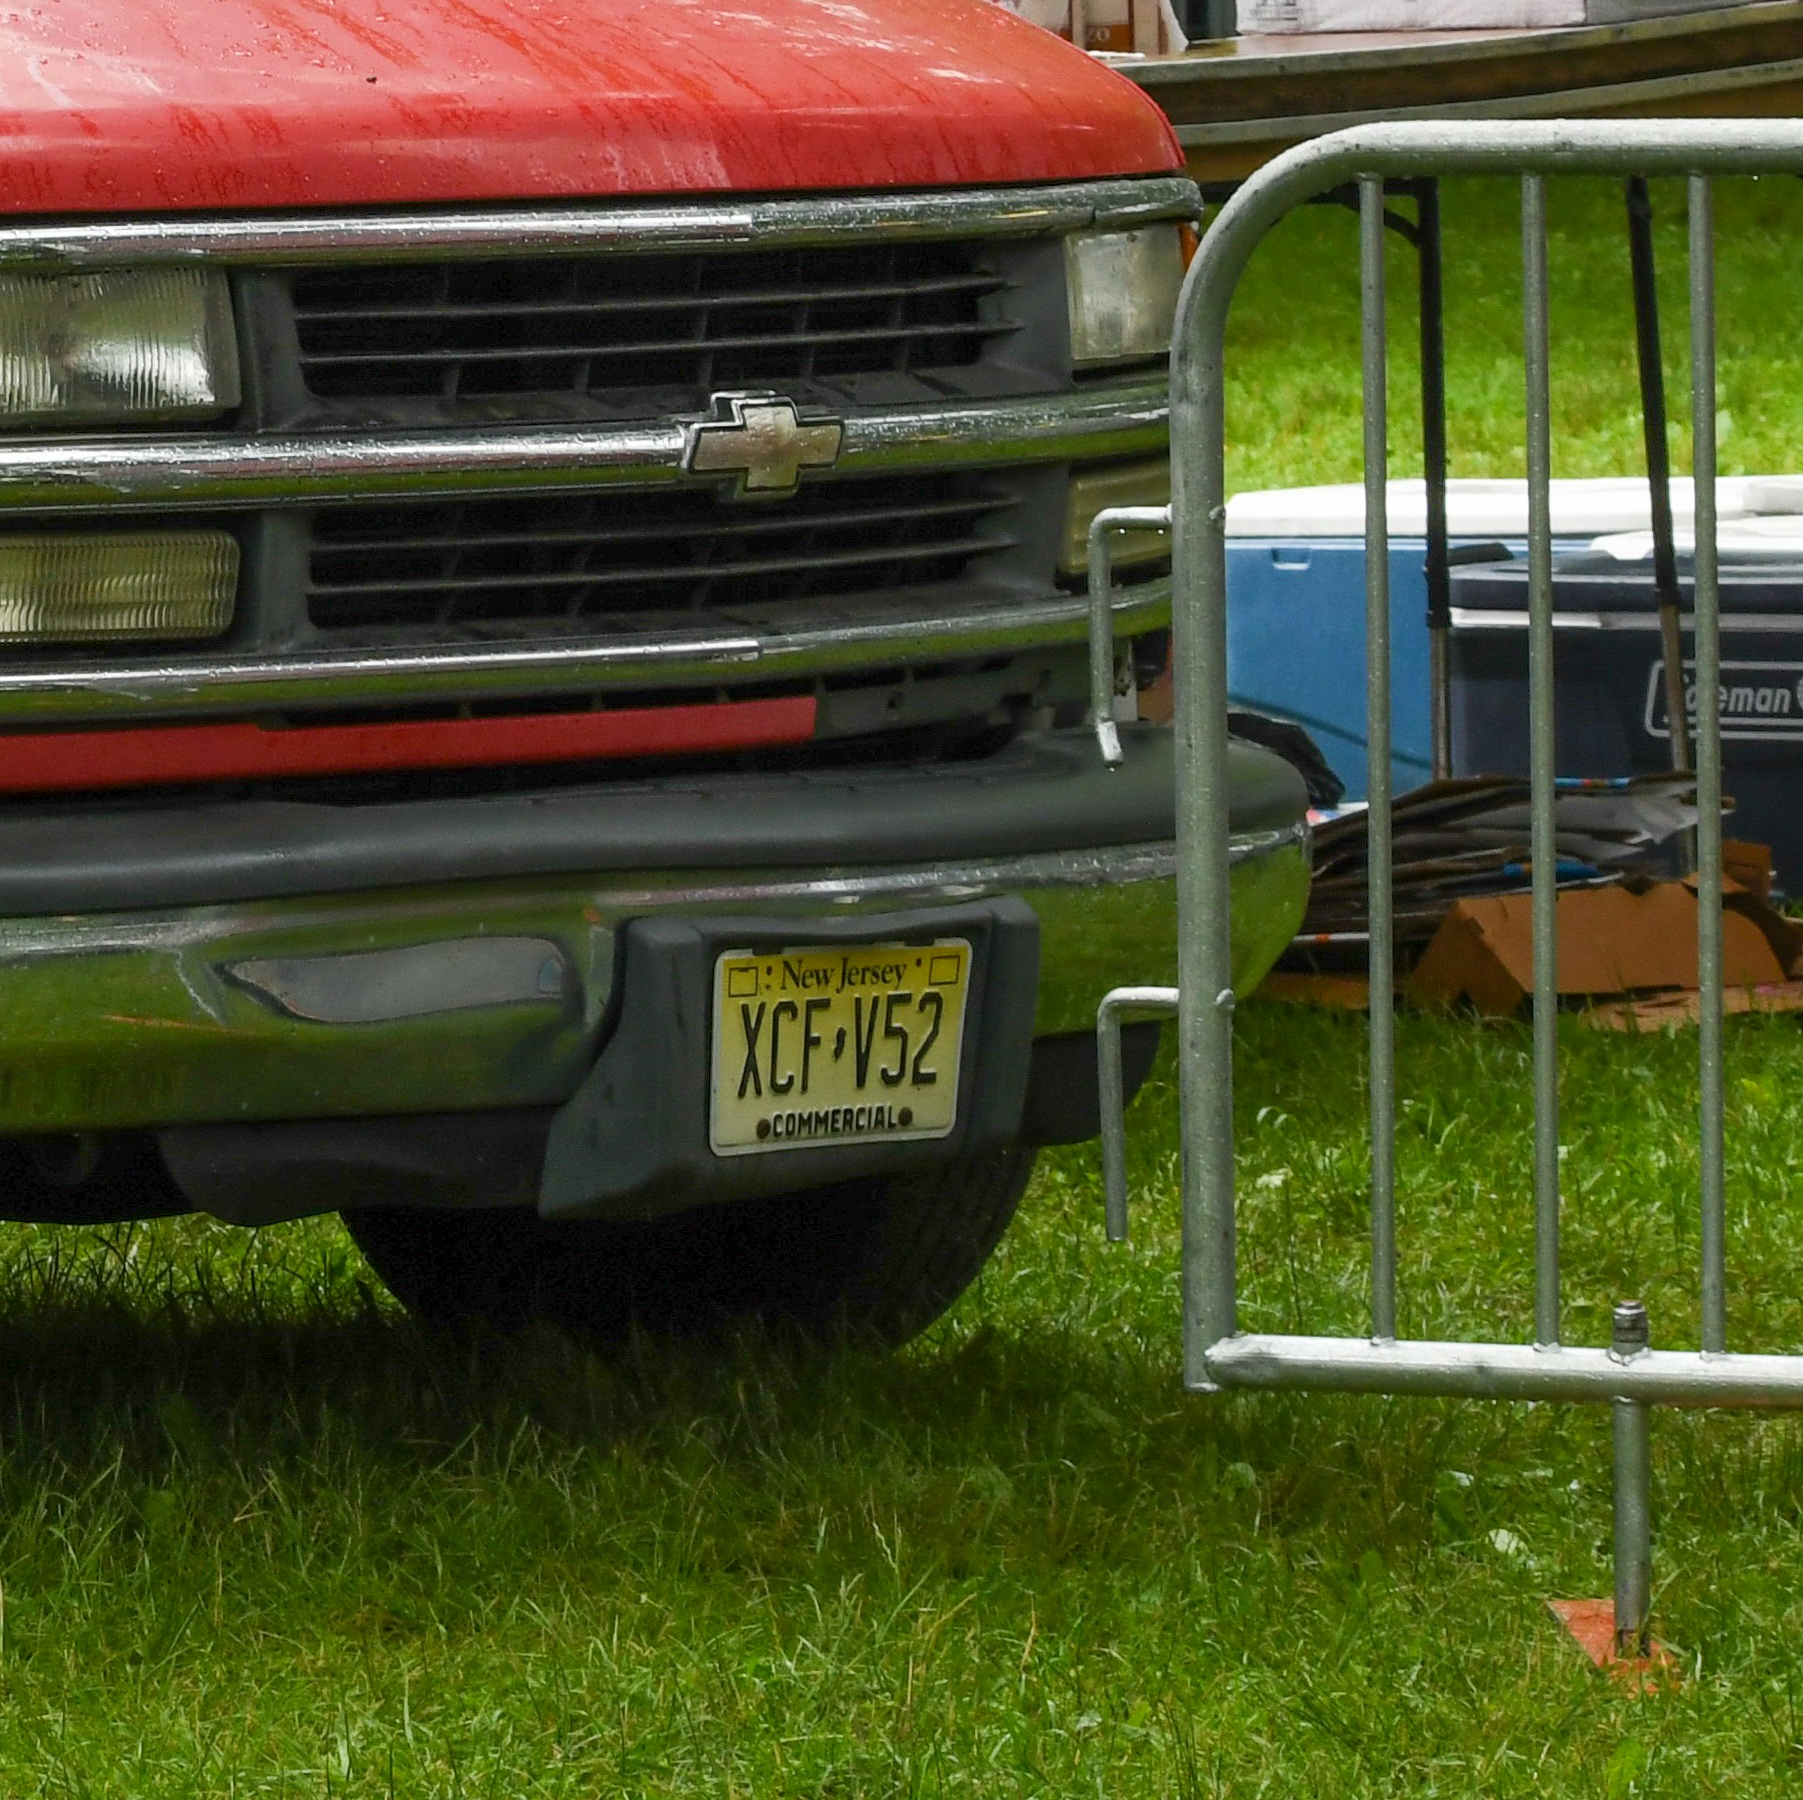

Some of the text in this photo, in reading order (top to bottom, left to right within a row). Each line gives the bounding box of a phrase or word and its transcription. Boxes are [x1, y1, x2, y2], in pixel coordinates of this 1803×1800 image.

[780, 956, 908, 994] New Jersey
[772, 1104, 897, 1138] COMMERCIAL
